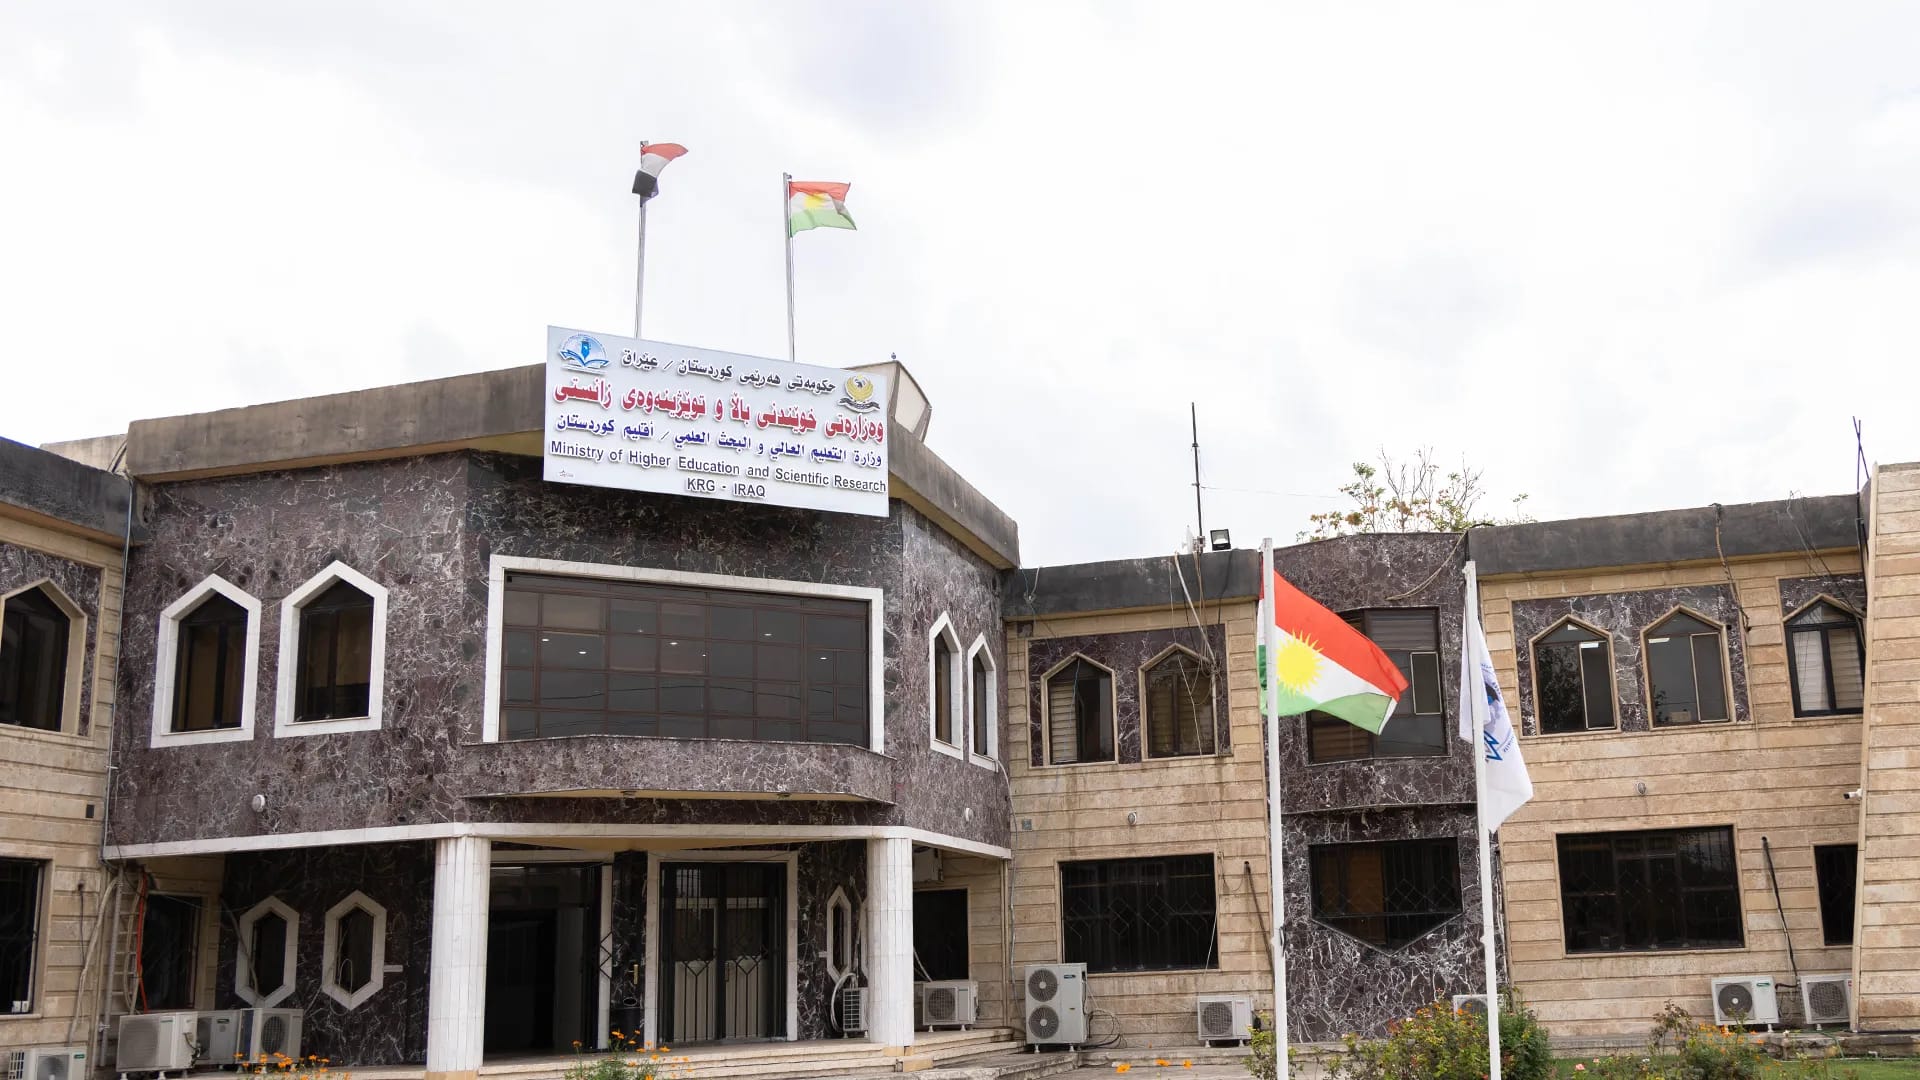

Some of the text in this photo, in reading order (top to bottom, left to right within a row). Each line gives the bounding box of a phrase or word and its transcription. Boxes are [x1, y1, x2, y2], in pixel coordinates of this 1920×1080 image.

[714, 399, 723, 420] و
[674, 430, 710, 449] العلمي
[718, 432, 751, 452] البحث
[757, 444, 764, 454] و
[770, 442, 804, 460] العالي
[811, 446, 846, 462] التعليم
[854, 449, 882, 466] وزارة
[551, 440, 886, 492] Ministry of Higher Education and Scientific Research
[687, 477, 716, 492] KRG
[734, 482, 766, 497] IRAQ
